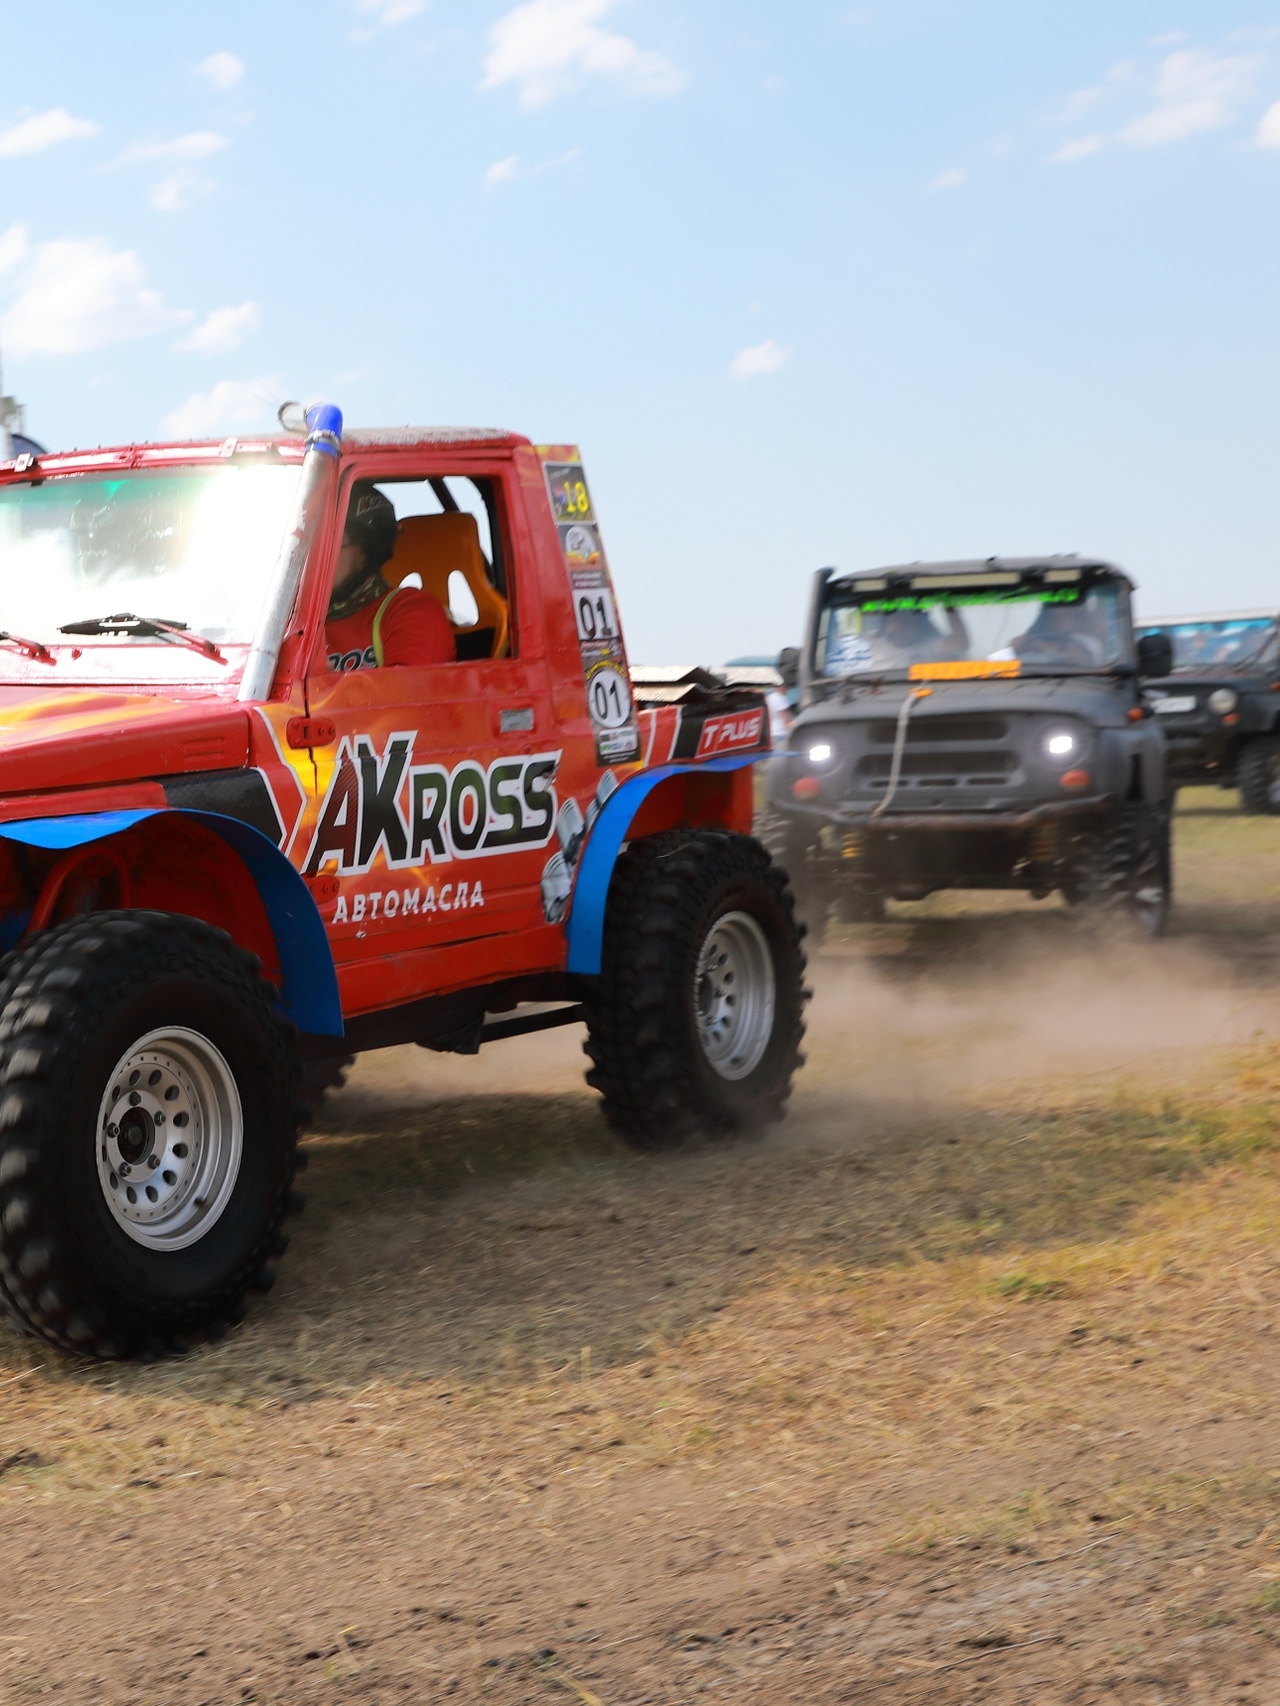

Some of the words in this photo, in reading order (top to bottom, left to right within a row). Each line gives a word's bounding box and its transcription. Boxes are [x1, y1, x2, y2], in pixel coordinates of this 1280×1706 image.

[563, 481, 589, 513] 18
[579, 596, 612, 640] 01
[595, 680, 622, 720] 01
[704, 724, 720, 750] T
[718, 716, 761, 743] PLUS
[300, 730, 562, 876] AKROSS
[331, 881, 485, 924] АВТОМАСЛА
